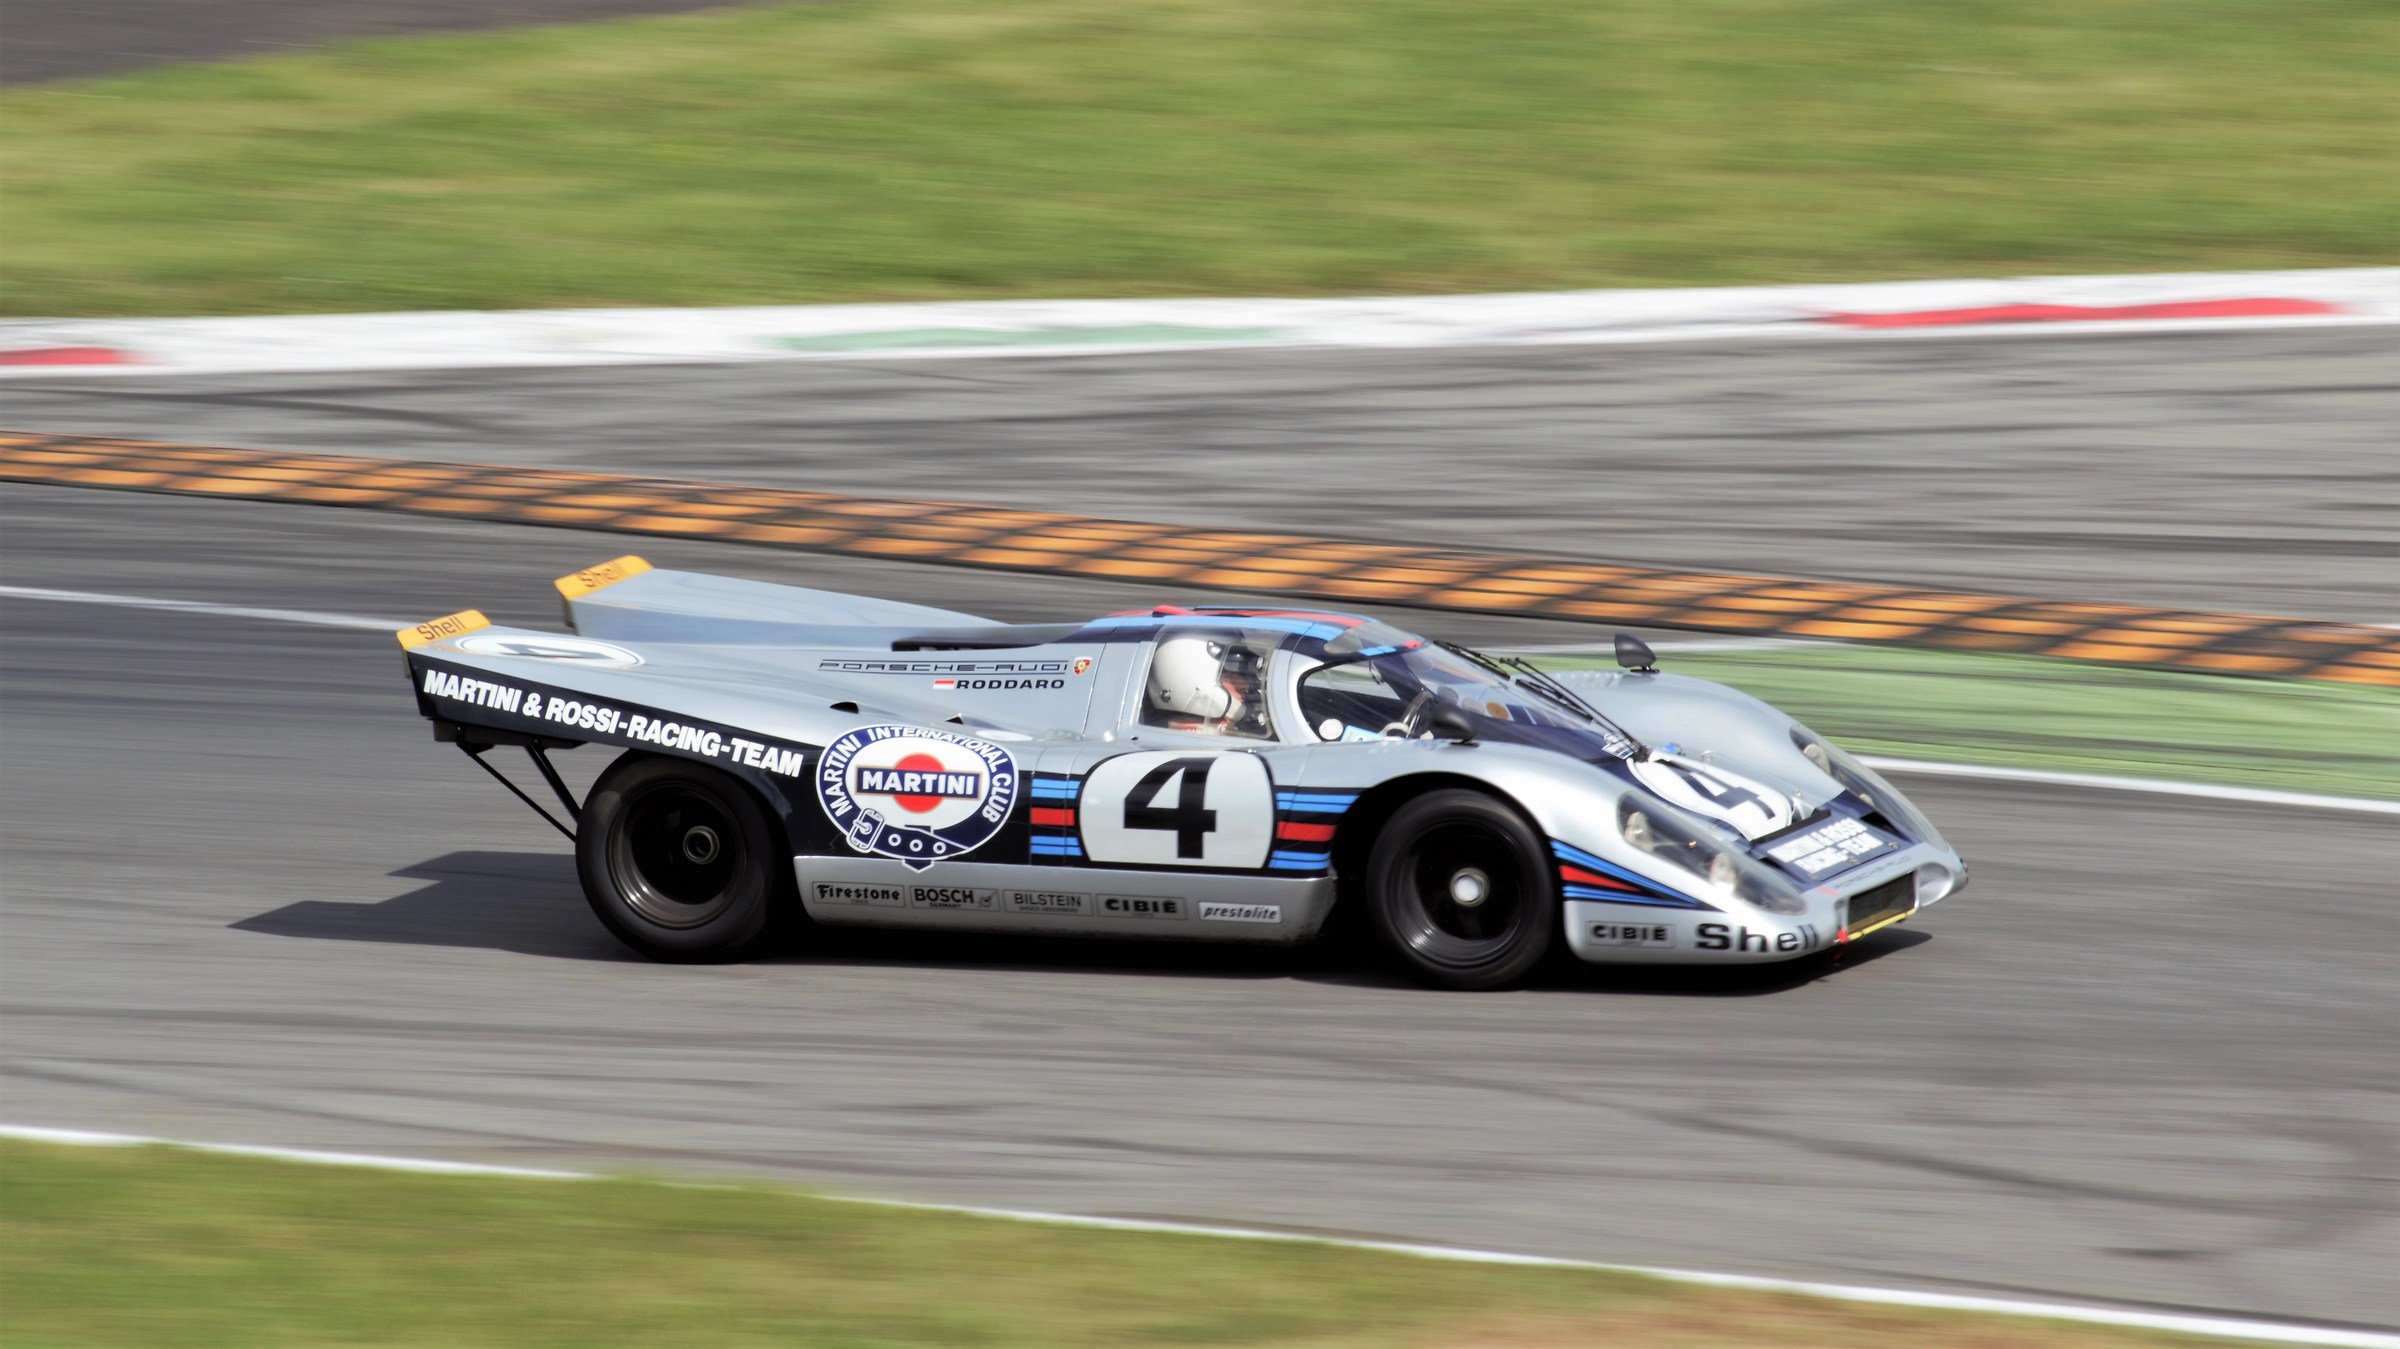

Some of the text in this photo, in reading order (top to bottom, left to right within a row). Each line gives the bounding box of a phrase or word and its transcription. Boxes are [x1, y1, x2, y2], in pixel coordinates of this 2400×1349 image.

[575, 562, 629, 588] Shell
[416, 615, 468, 641] Shell
[819, 662, 1069, 672] PORSCHE-AUDI
[956, 679, 1065, 690] RODDARO
[423, 669, 803, 778] MARTINI & ROSSI-RACING-TEAM
[823, 726, 1012, 824] MARTINI INTERNATIONAL CLUB
[862, 770, 975, 796] MARTINI
[1123, 757, 1217, 860] 4
[816, 884, 900, 901] Firestone
[914, 888, 974, 904] BOSCH
[1014, 893, 1081, 907] BILSTEIN
[1203, 905, 1278, 920] prestolite
[1695, 922, 1818, 953] Shell
